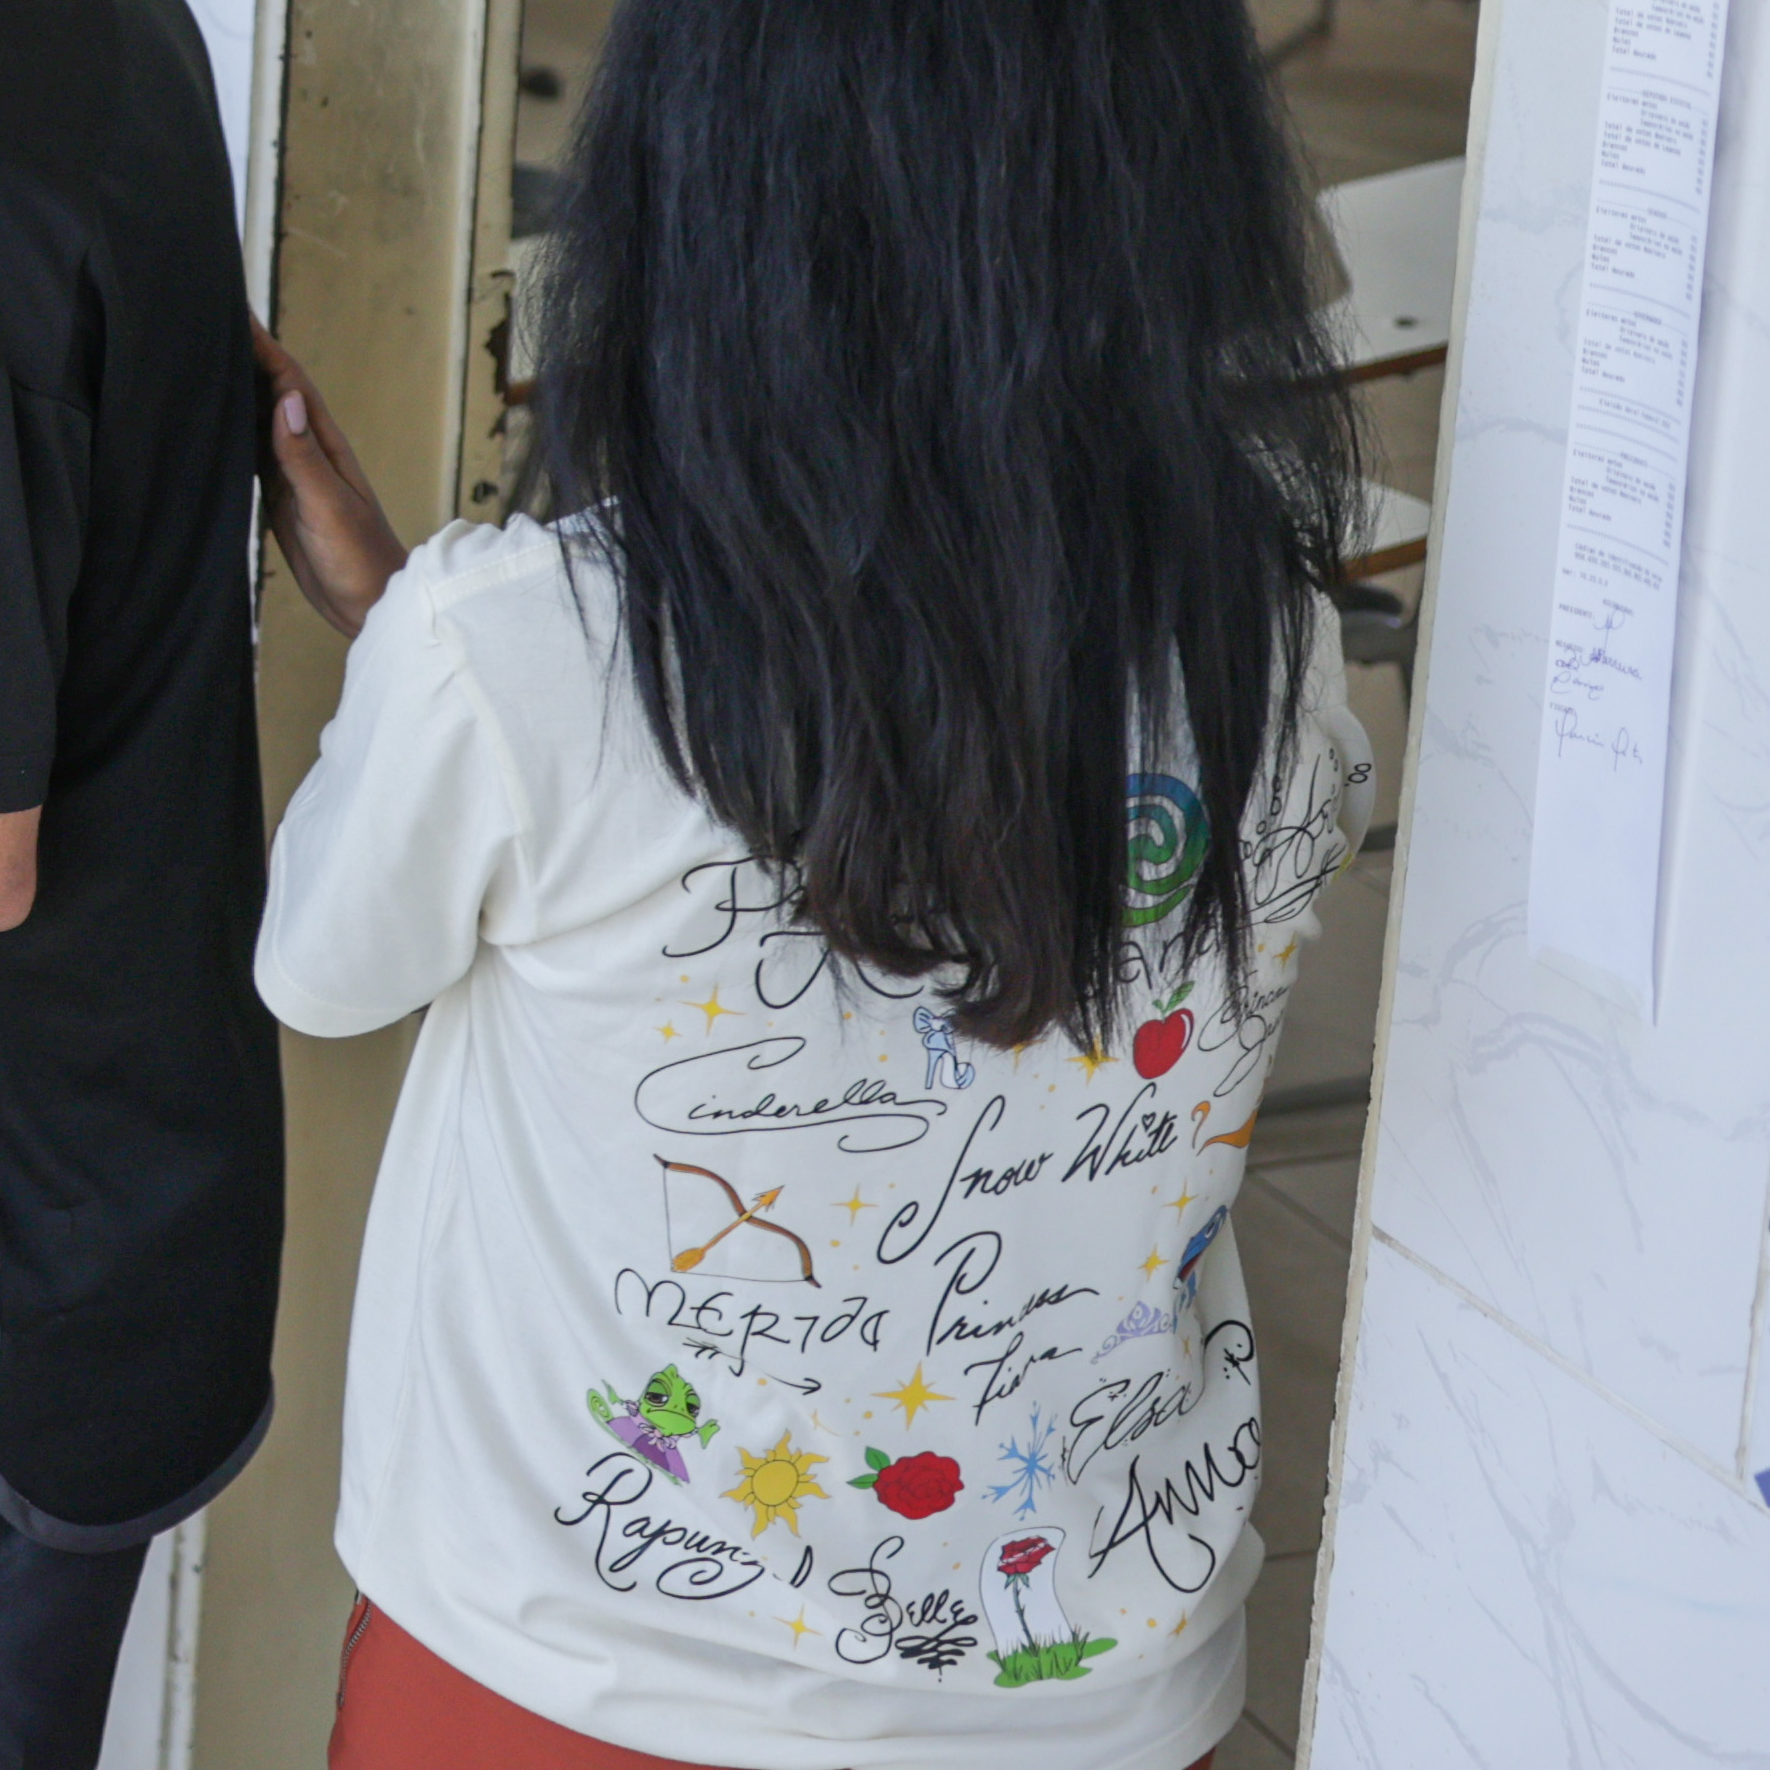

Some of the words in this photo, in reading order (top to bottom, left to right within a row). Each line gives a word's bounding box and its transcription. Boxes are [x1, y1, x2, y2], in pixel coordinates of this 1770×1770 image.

[635, 1035, 947, 1152] Cinderella
[876, 1093, 1054, 1264] Snow
[1060, 1081, 1179, 1183] White
[1067, 1340, 1225, 1485] Elsa
